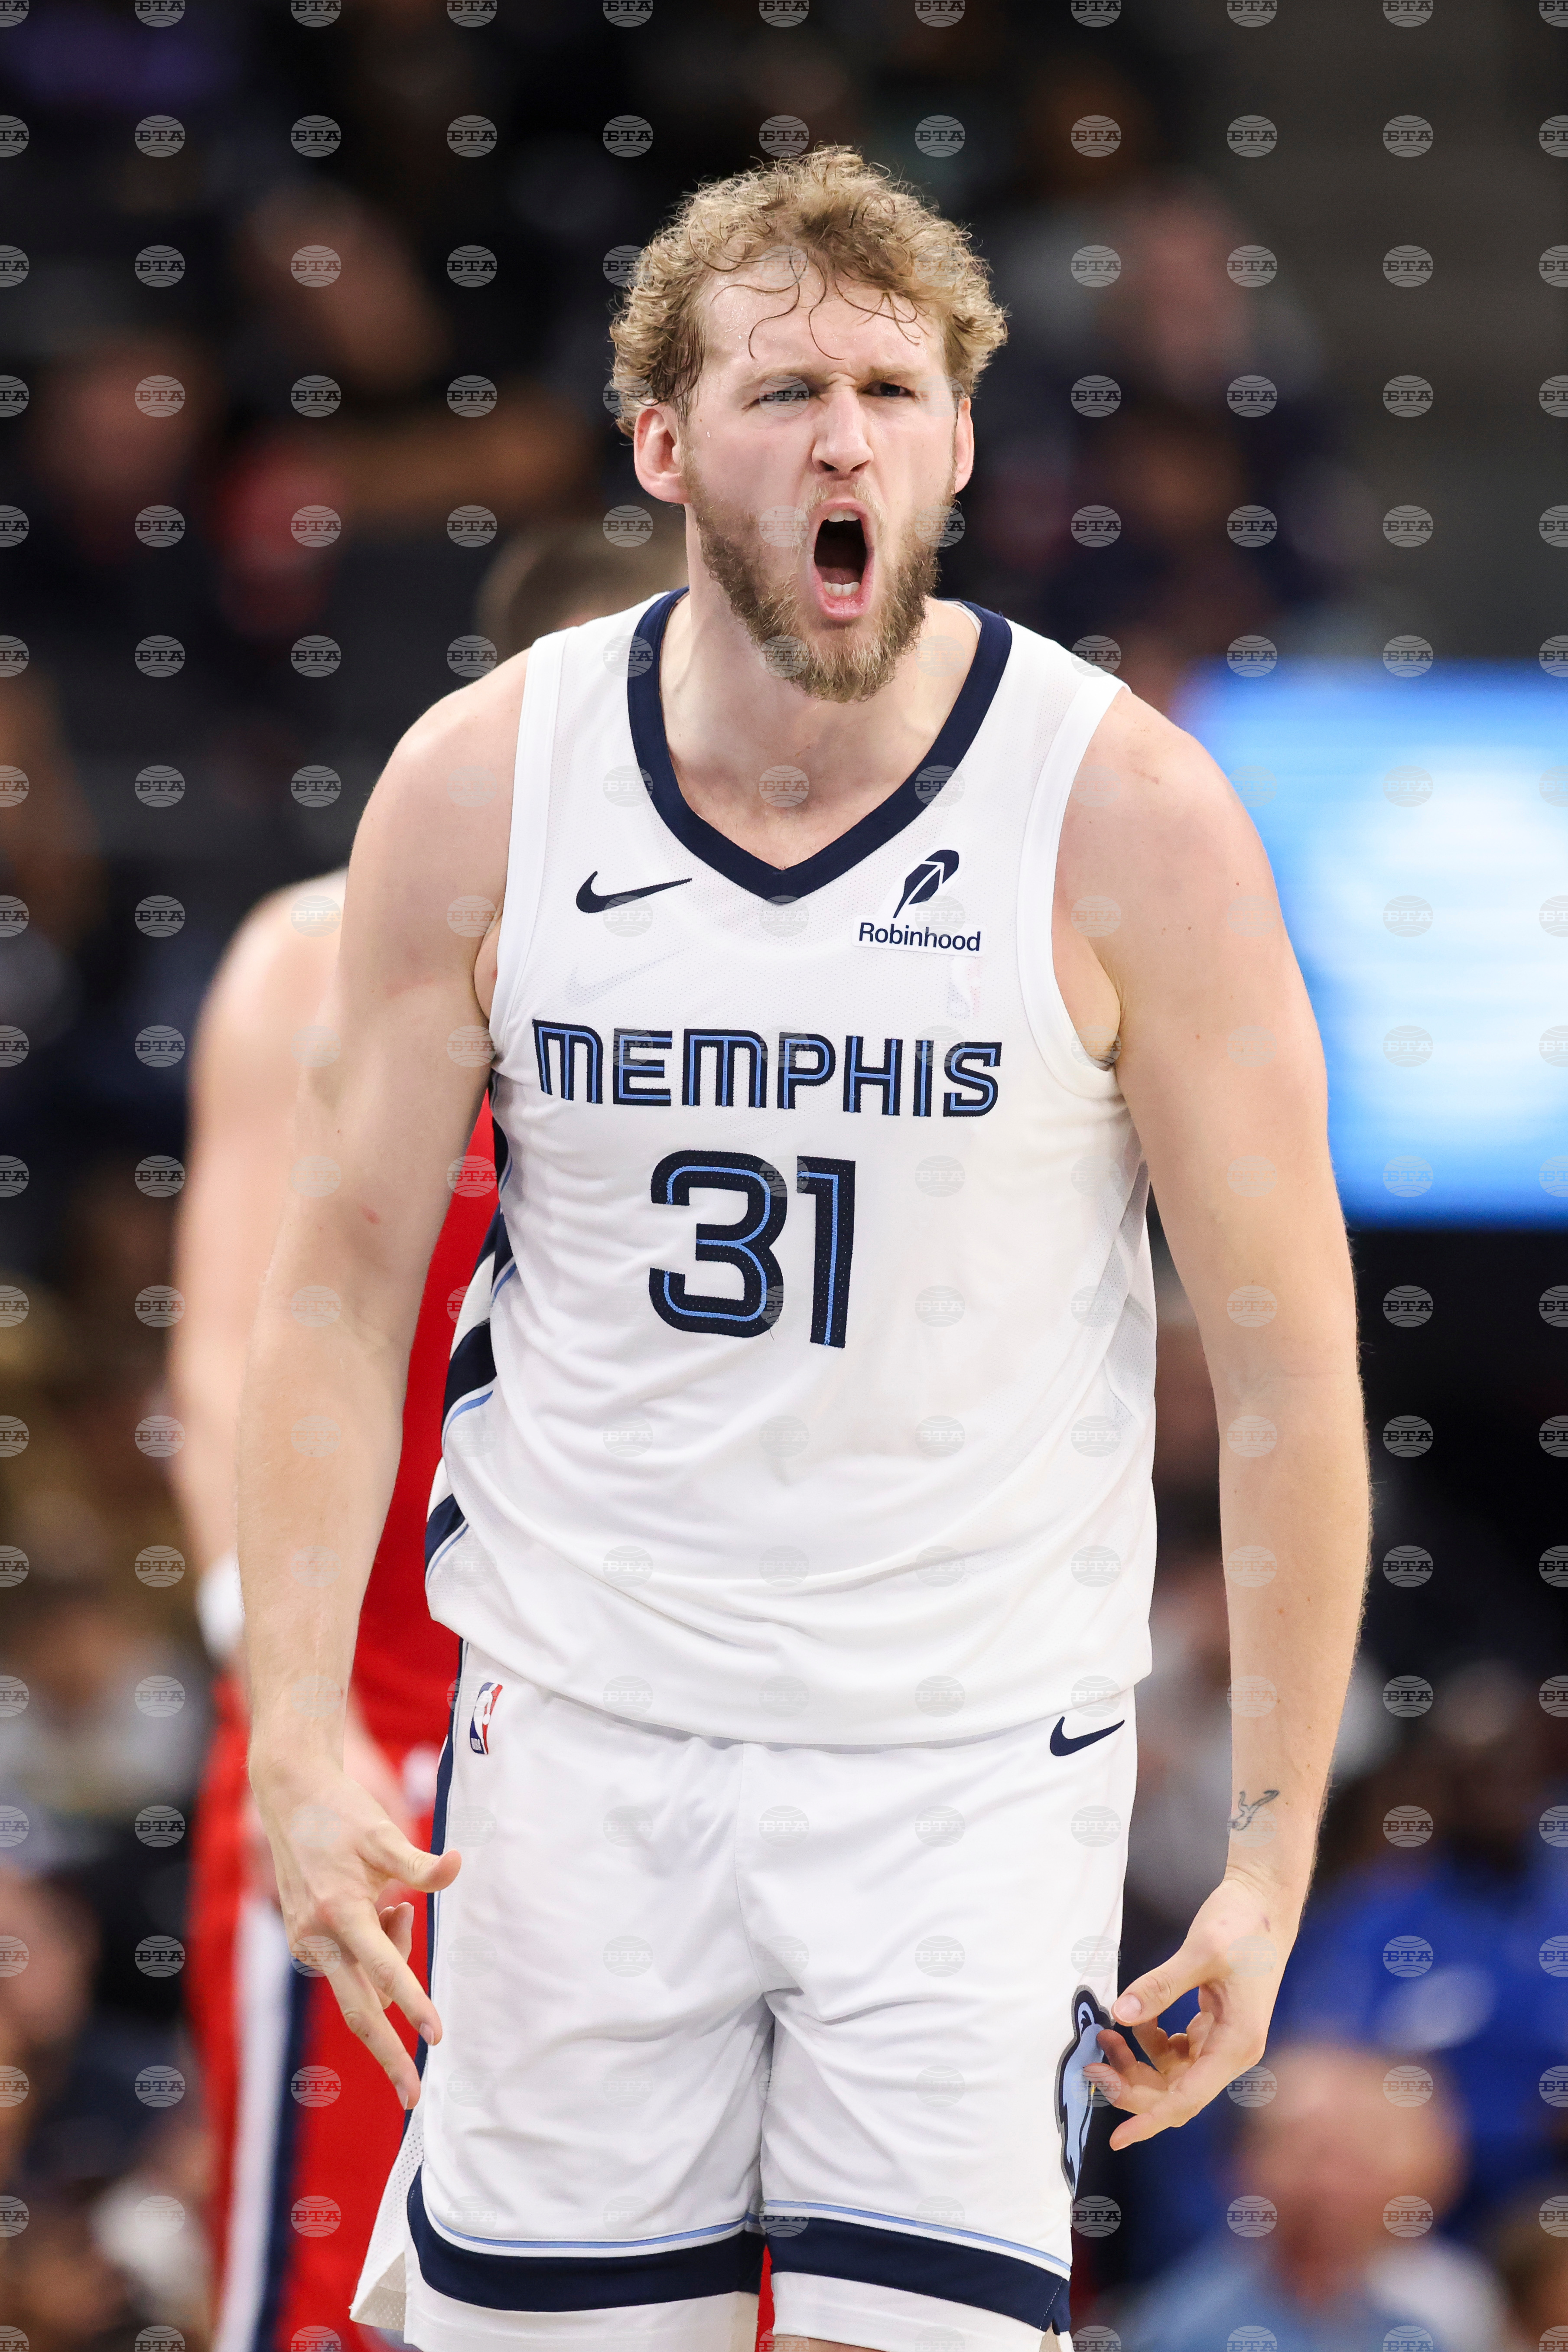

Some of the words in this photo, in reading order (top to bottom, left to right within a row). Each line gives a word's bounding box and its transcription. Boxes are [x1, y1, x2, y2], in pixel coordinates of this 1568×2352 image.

[859, 923, 980, 951] Robinhood
[532, 1019, 1002, 1117] MEMPHIS
[649, 1150, 856, 1349] 31
